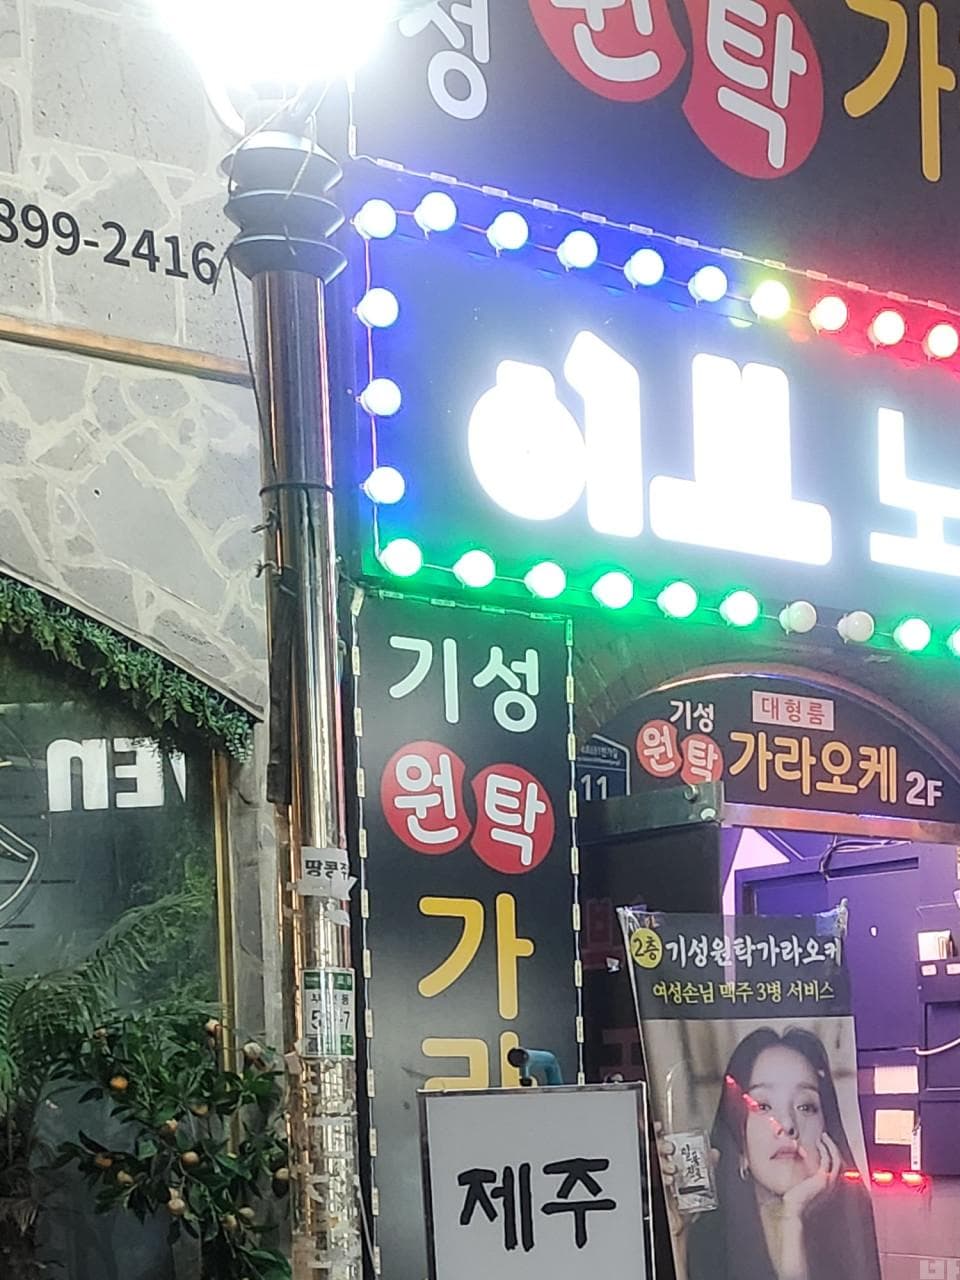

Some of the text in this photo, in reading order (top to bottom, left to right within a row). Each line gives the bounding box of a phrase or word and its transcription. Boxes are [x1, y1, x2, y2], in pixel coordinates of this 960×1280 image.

[389, 635, 539, 732] 기성
[669, 700, 715, 732] 기성
[761, 697, 827, 726] 대형룸
[641, 726, 720, 782] 원탁
[730, 731, 897, 803] 가라오케
[581, 774, 606, 800] 11
[906, 772, 942, 806] 2F
[393, 753, 546, 866] 원탁
[634, 936, 660, 960] 2층
[653, 980, 835, 1003] 여성손님 맥주 3병 서비스
[457, 1157, 616, 1251] 제주
